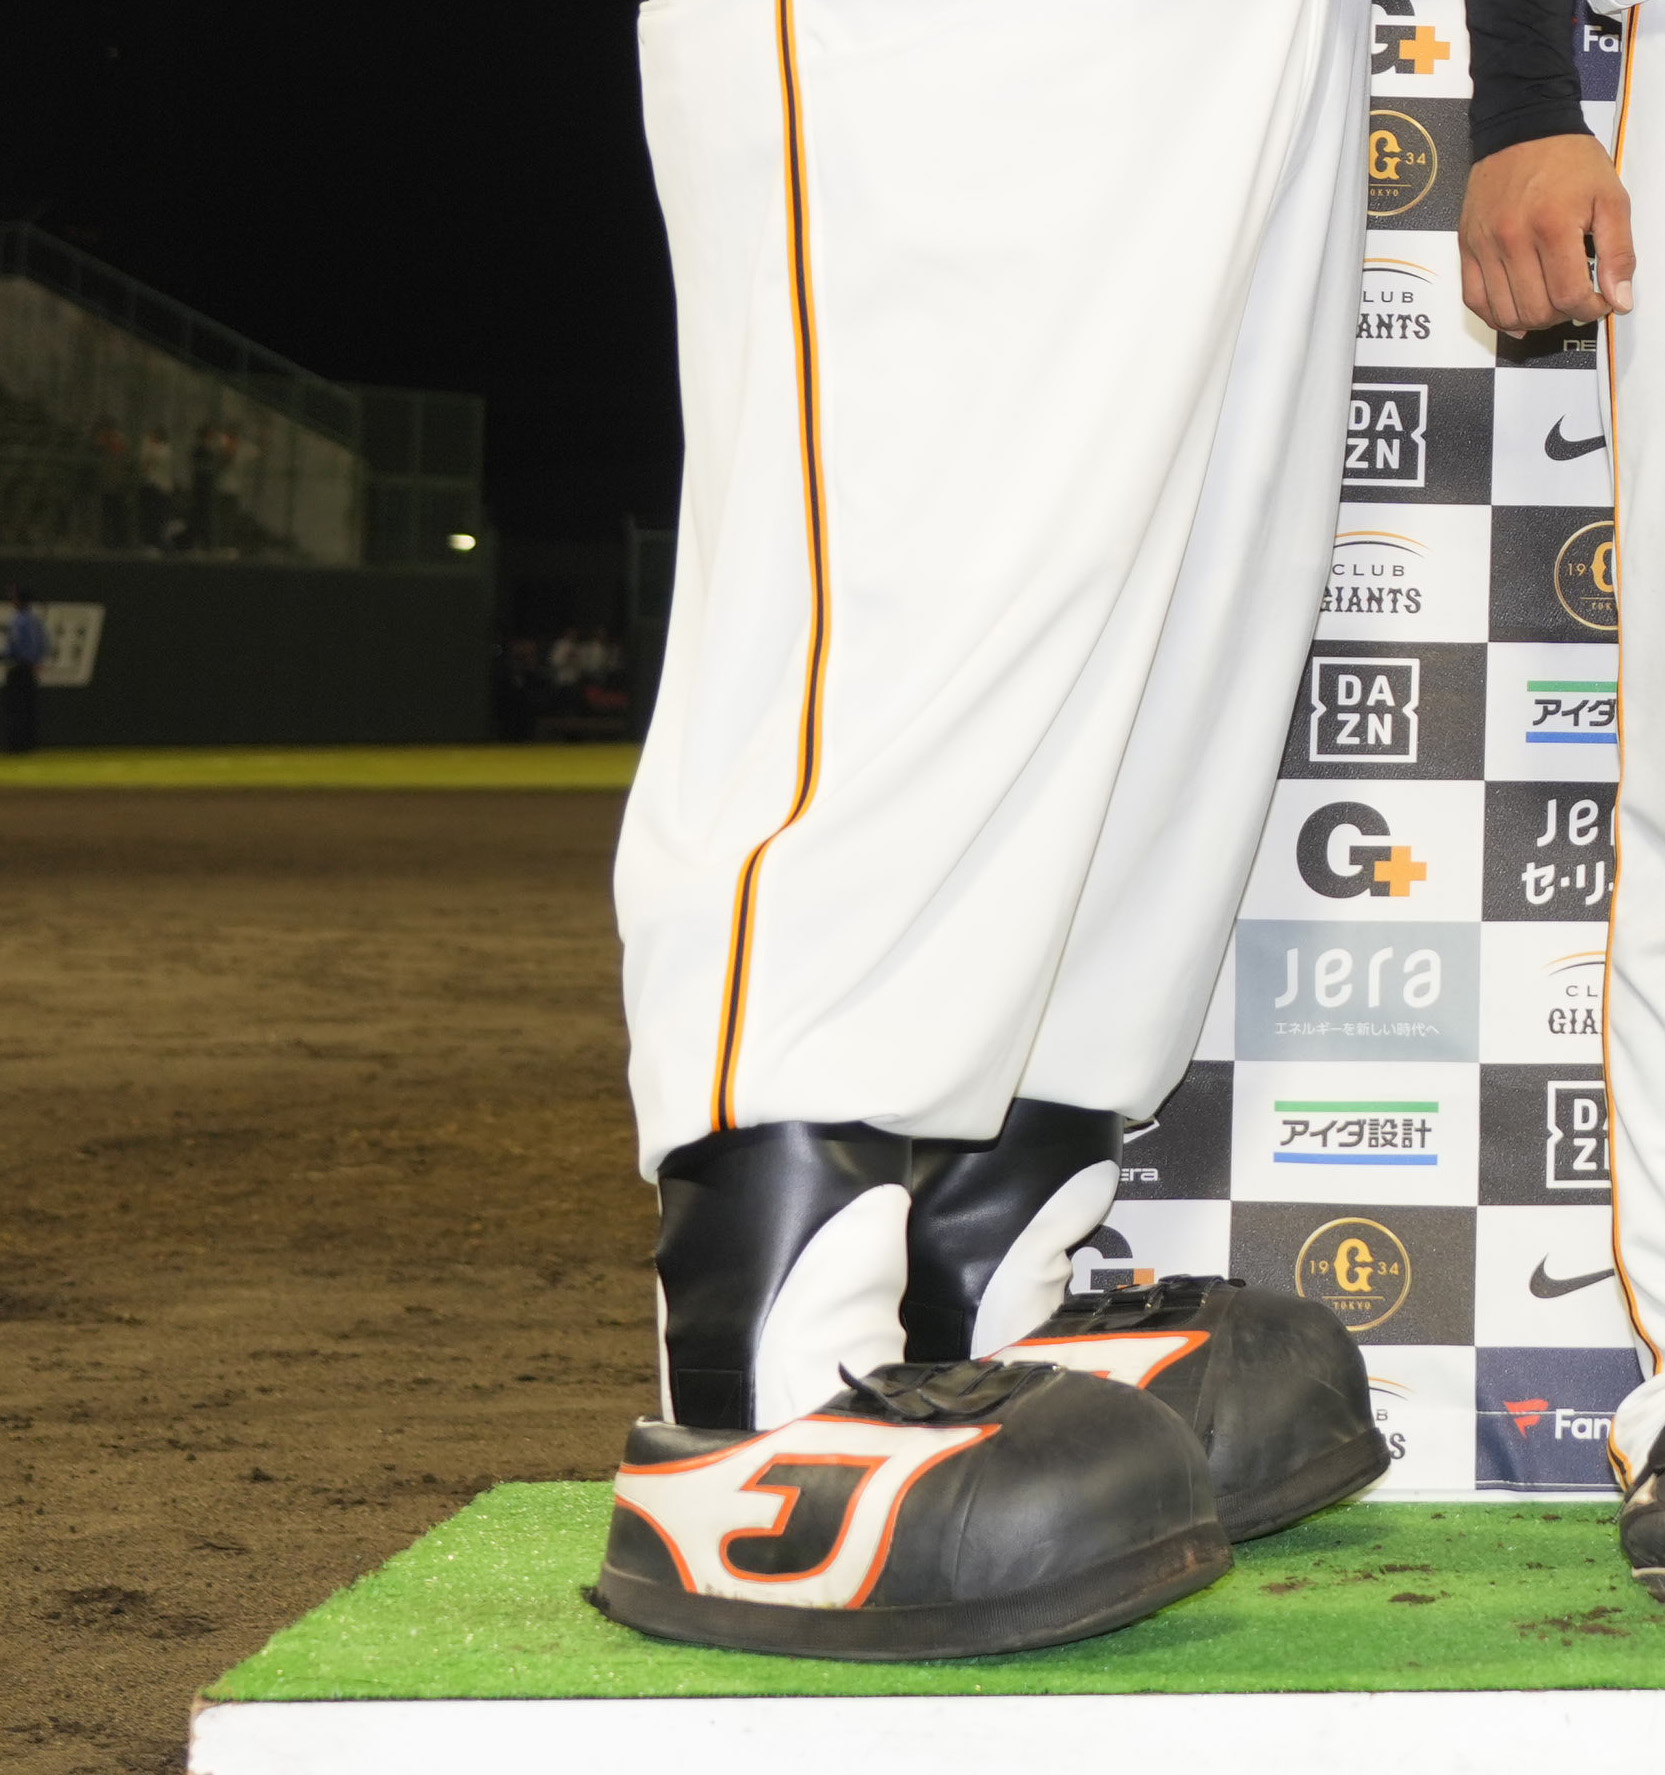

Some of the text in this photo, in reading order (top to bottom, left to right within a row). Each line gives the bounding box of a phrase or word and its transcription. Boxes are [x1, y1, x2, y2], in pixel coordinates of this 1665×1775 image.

[1279, 1118, 1432, 1148] アイダ設計
